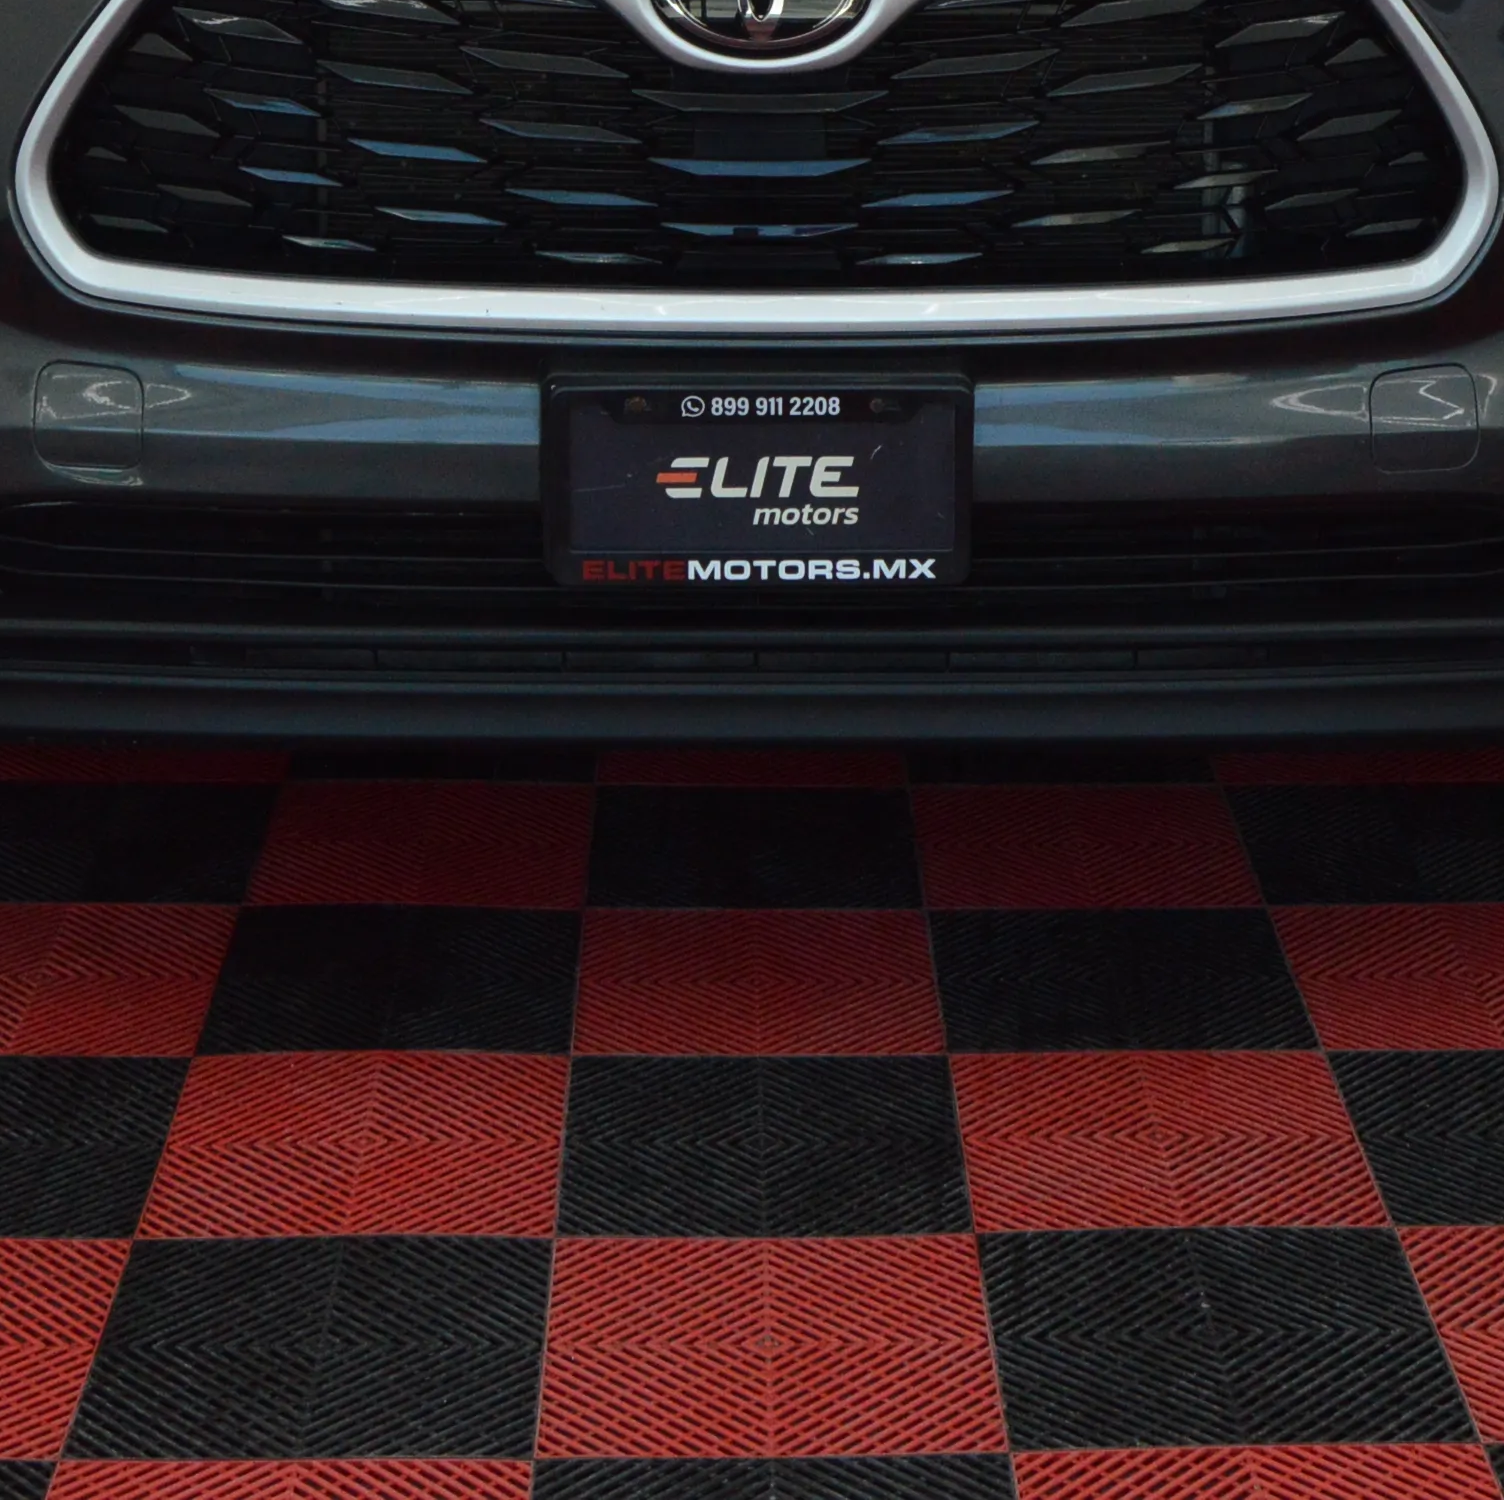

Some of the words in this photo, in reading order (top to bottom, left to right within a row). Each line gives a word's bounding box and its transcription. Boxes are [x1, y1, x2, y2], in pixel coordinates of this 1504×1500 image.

[710, 396, 749, 417] 899
[755, 396, 784, 417] 911
[789, 396, 841, 417] 2208
[655, 456, 860, 499] ELITE
[752, 503, 860, 526] motors
[582, 558, 936, 581] ELITEMOTORS.MX
